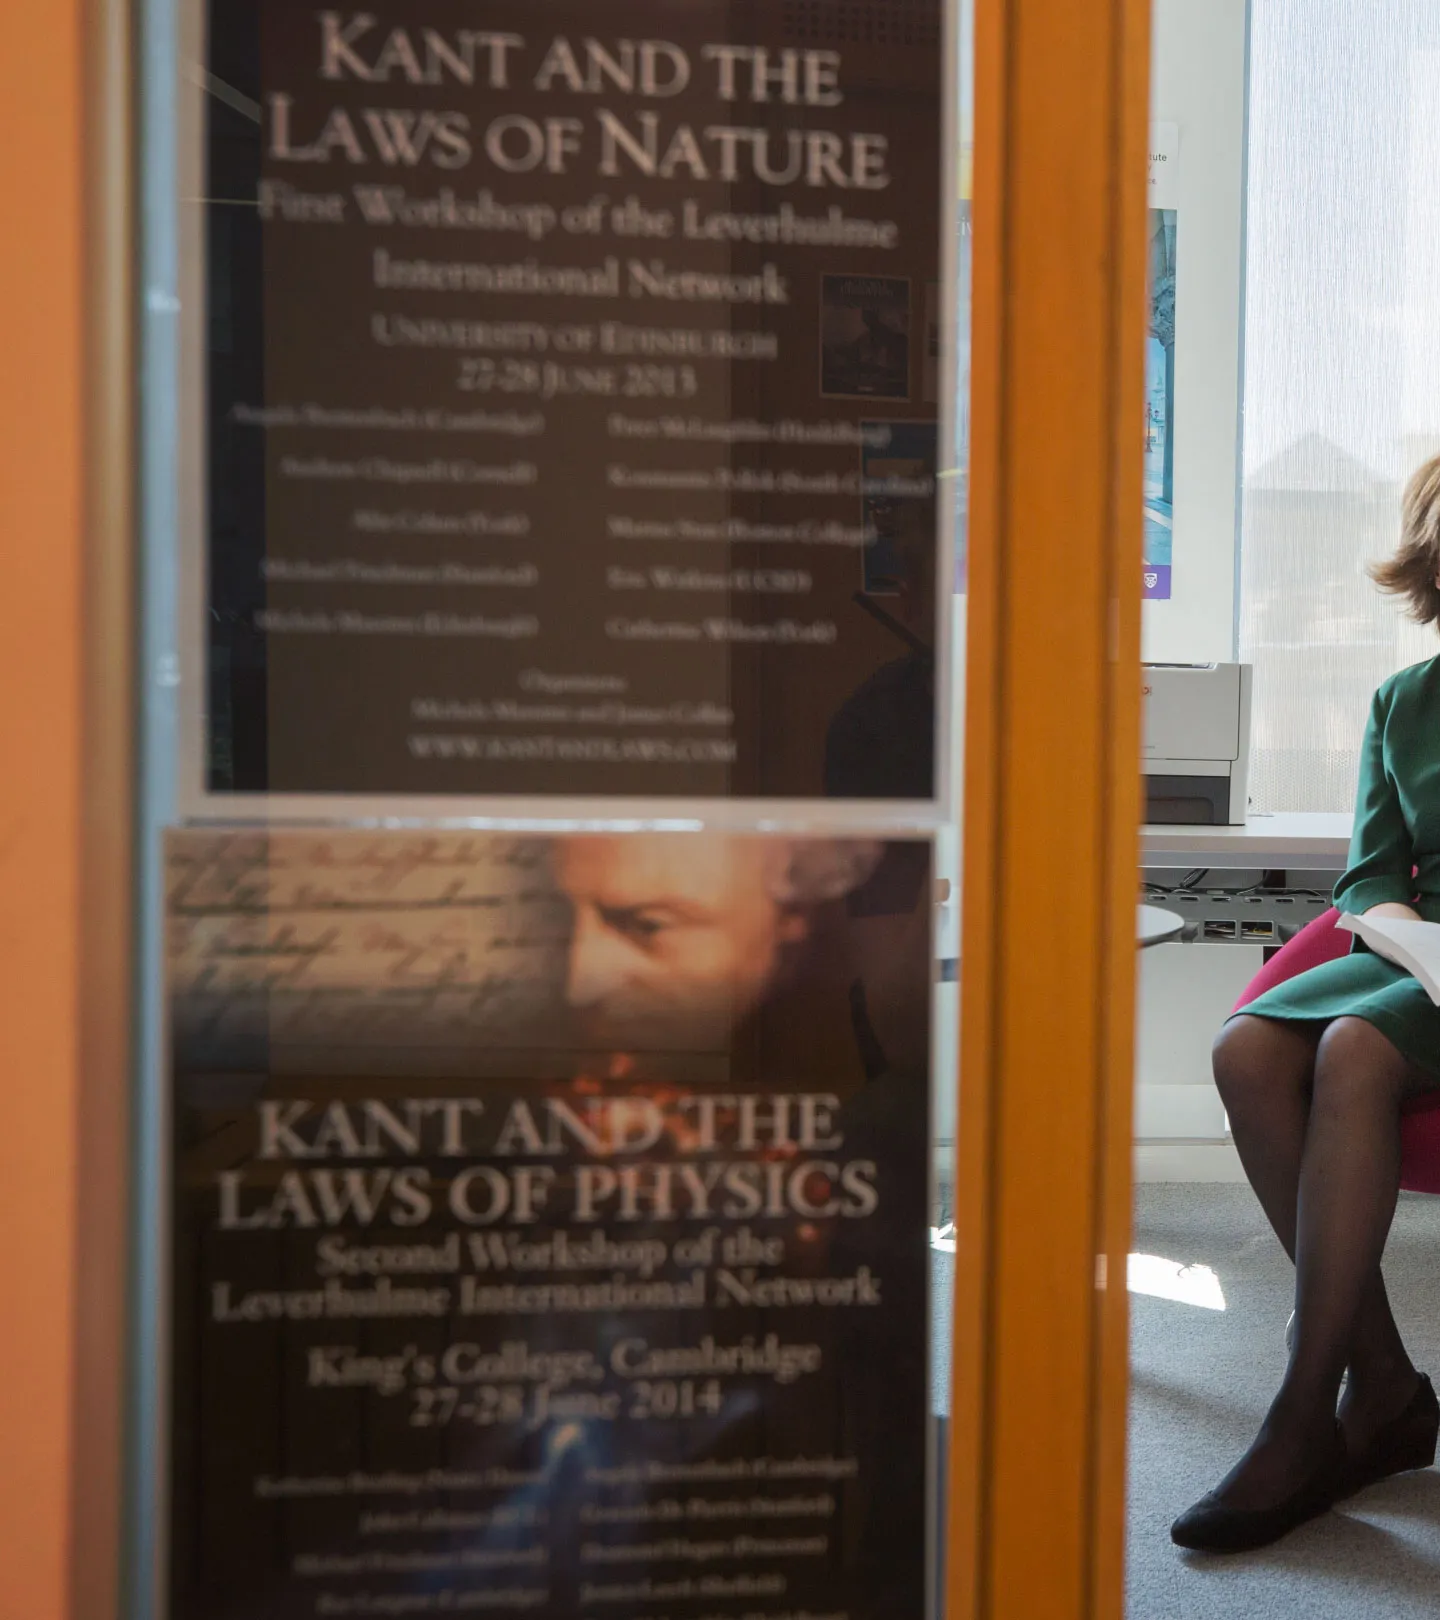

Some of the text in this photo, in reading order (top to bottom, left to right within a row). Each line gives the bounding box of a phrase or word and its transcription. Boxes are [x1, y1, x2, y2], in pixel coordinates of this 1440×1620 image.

[319, 11, 843, 106] KANT AND THE
[269, 92, 893, 190] LAWS OF NATURE
[257, 179, 899, 249] First Workshop of the Leverhulme
[373, 247, 789, 306] International Network
[370, 312, 778, 361] UNIVERSITY OF EDINBURGH
[539, 359, 617, 399] JUNE
[257, 1092, 844, 1160] KANT AND THE
[215, 1158, 880, 1230] LAWS OF PHYSICS
[314, 1223, 786, 1277] Second Workshop of the
[211, 1264, 882, 1322] Leverhulme International Network
[305, 1332, 822, 1397] King's College, Cambridge
[408, 1378, 722, 1432] 27-28 June 2014
